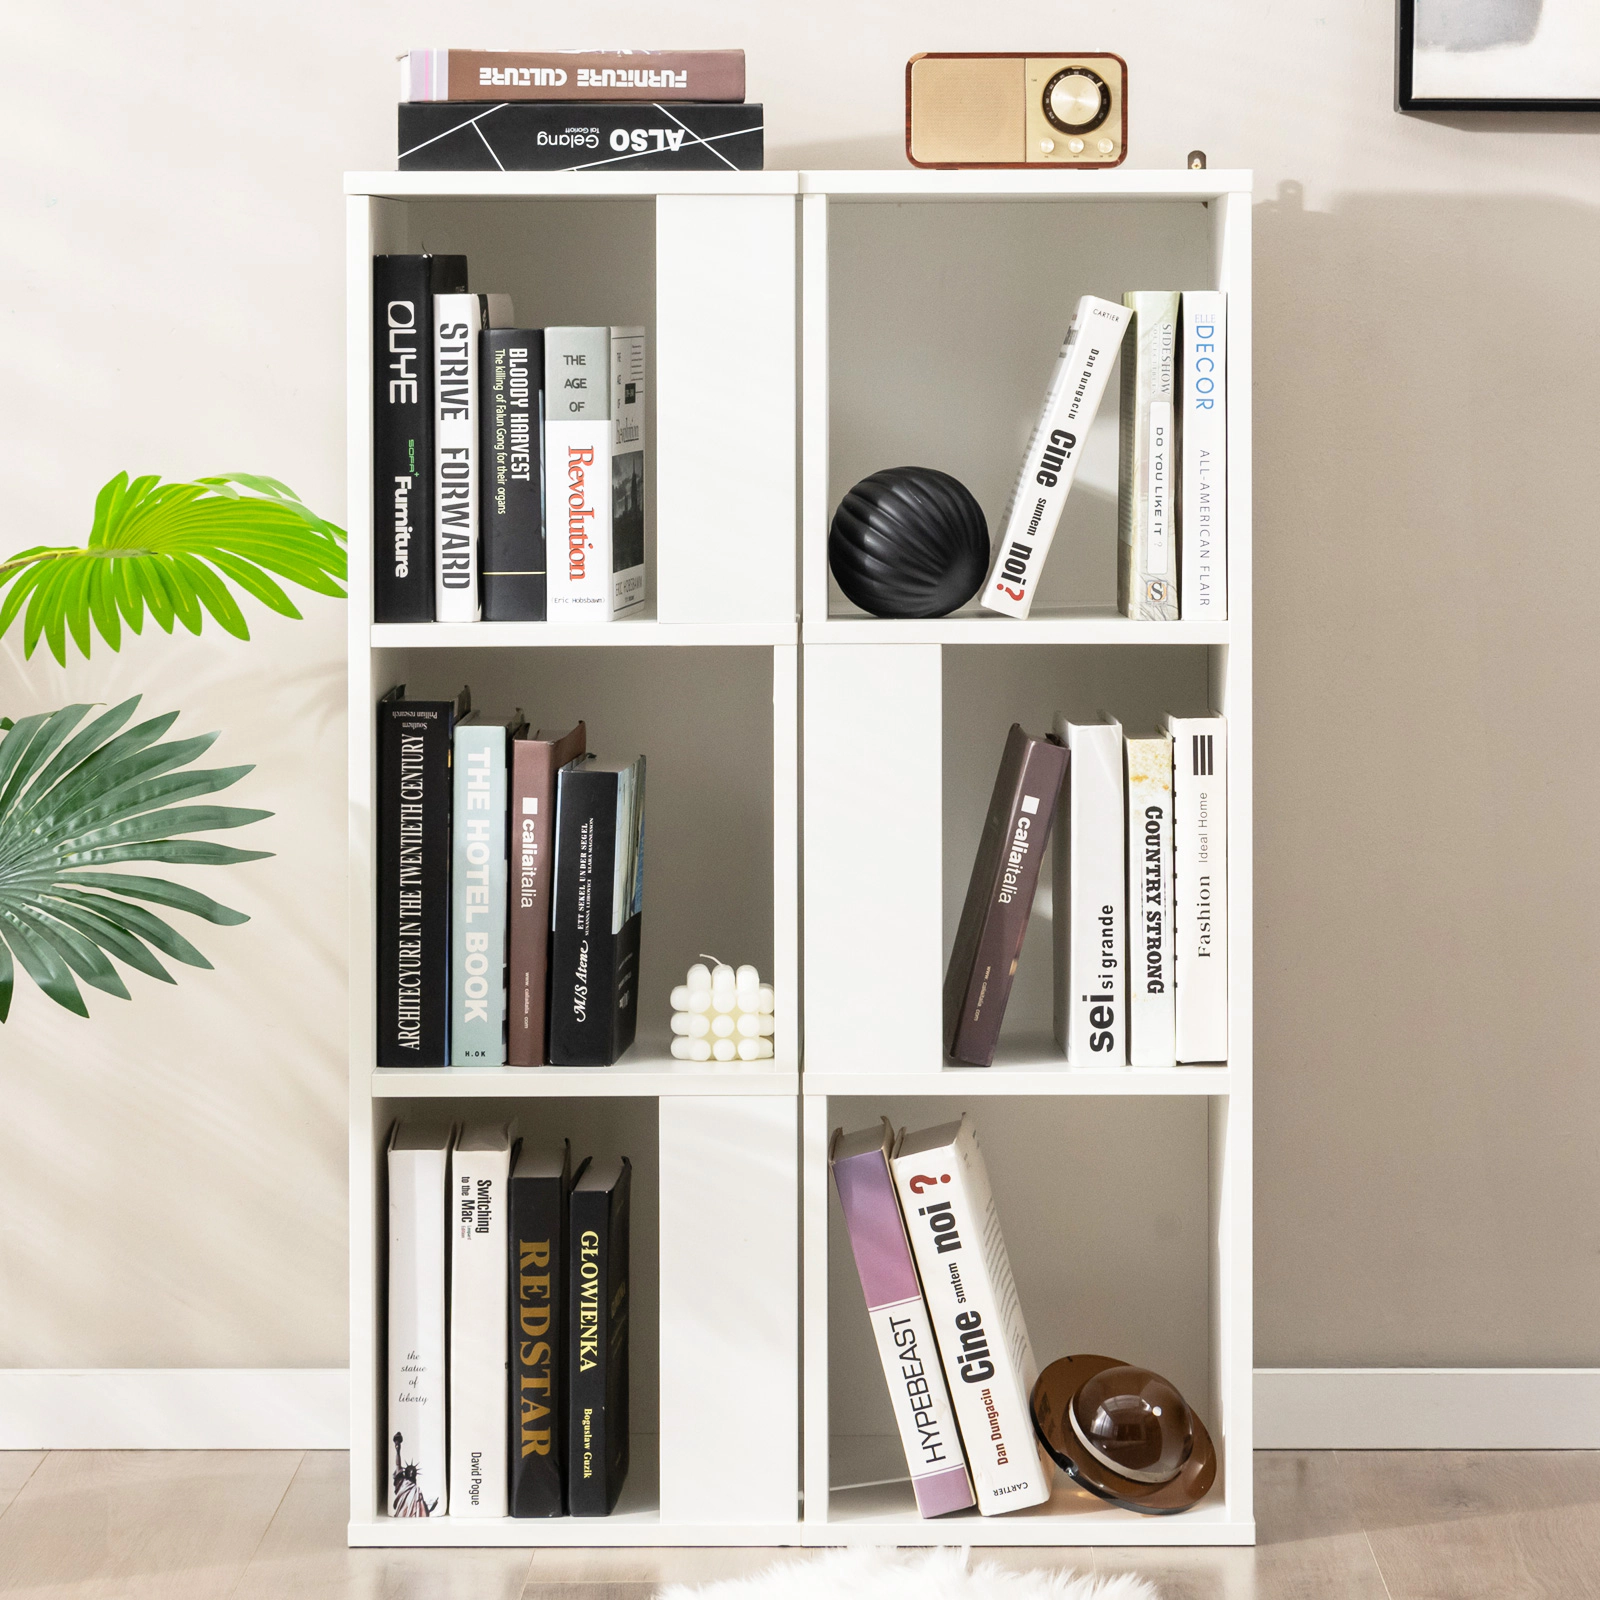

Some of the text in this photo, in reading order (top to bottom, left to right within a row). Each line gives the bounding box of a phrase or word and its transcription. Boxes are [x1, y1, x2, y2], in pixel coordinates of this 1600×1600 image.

[479, 67, 568, 88] CULTURE
[537, 128, 685, 151] ALSO Gelang
[1093, 308, 1120, 322] CARTIER
[1194, 313, 1216, 324] ELLE
[387, 300, 418, 404] OUYE
[563, 355, 586, 366] THE
[1086, 348, 1099, 368] Dan
[1161, 323, 1172, 395] SIDESHOW
[1195, 325, 1215, 410] DECOR
[564, 378, 587, 389] AGE
[569, 401, 585, 412] OF
[1068, 370, 1092, 420] Dungaciu
[493, 349, 508, 515] The killing of Falun Gong for their organs
[509, 348, 530, 482] BLOODY HARVEST
[1156, 427, 1164, 447] DO
[439, 323, 471, 589] STRIVE FORWARD
[1036, 428, 1077, 488] Cine
[1155, 453, 1163, 481] YOU
[394, 476, 414, 578] Furniture
[568, 445, 595, 581] Revolution
[1026, 497, 1047, 537] suntem
[1154, 486, 1163, 517] LIKE
[1199, 449, 1211, 607] ALL-AMERICAN FLAIR
[1154, 522, 1163, 536] IT
[401, 733, 424, 801] CENTURY
[400, 803, 423, 887] TWENTIETH
[1198, 792, 1208, 863] Ideal Home
[464, 747, 491, 1024] THE HOTEL BOOK
[520, 818, 538, 909] caliaitalia
[577, 822, 588, 930] ETT SEKEL UNDER SEGEL
[997, 816, 1031, 905] caliaitalia
[399, 889, 422, 919] THE
[1145, 806, 1165, 994] COUNTRY STRONG
[1197, 875, 1211, 958] Fashion
[399, 921, 422, 937] IN
[573, 939, 589, 1023] M/S Atene
[1082, 904, 1117, 1053] sei si grande
[461, 1176, 475, 1223] to the Mac
[475, 1179, 493, 1234] Switching
[918, 1201, 962, 1255] noi
[580, 1230, 599, 1373] GŁOWIENKA
[400, 1364, 427, 1373] statue
[407, 1350, 420, 1360] the
[955, 1310, 995, 1384] Cine
[398, 1392, 428, 1405] liberty
[408, 1375, 418, 1389] of
[889, 1316, 946, 1464] HYPEBEAST
[980, 1388, 1003, 1441] Dungaciu
[468, 1452, 482, 1506] David Pogue
[583, 1452, 593, 1479] Guzik
[997, 1443, 1009, 1466] Dan
[993, 1481, 1029, 1497] CARTIER
